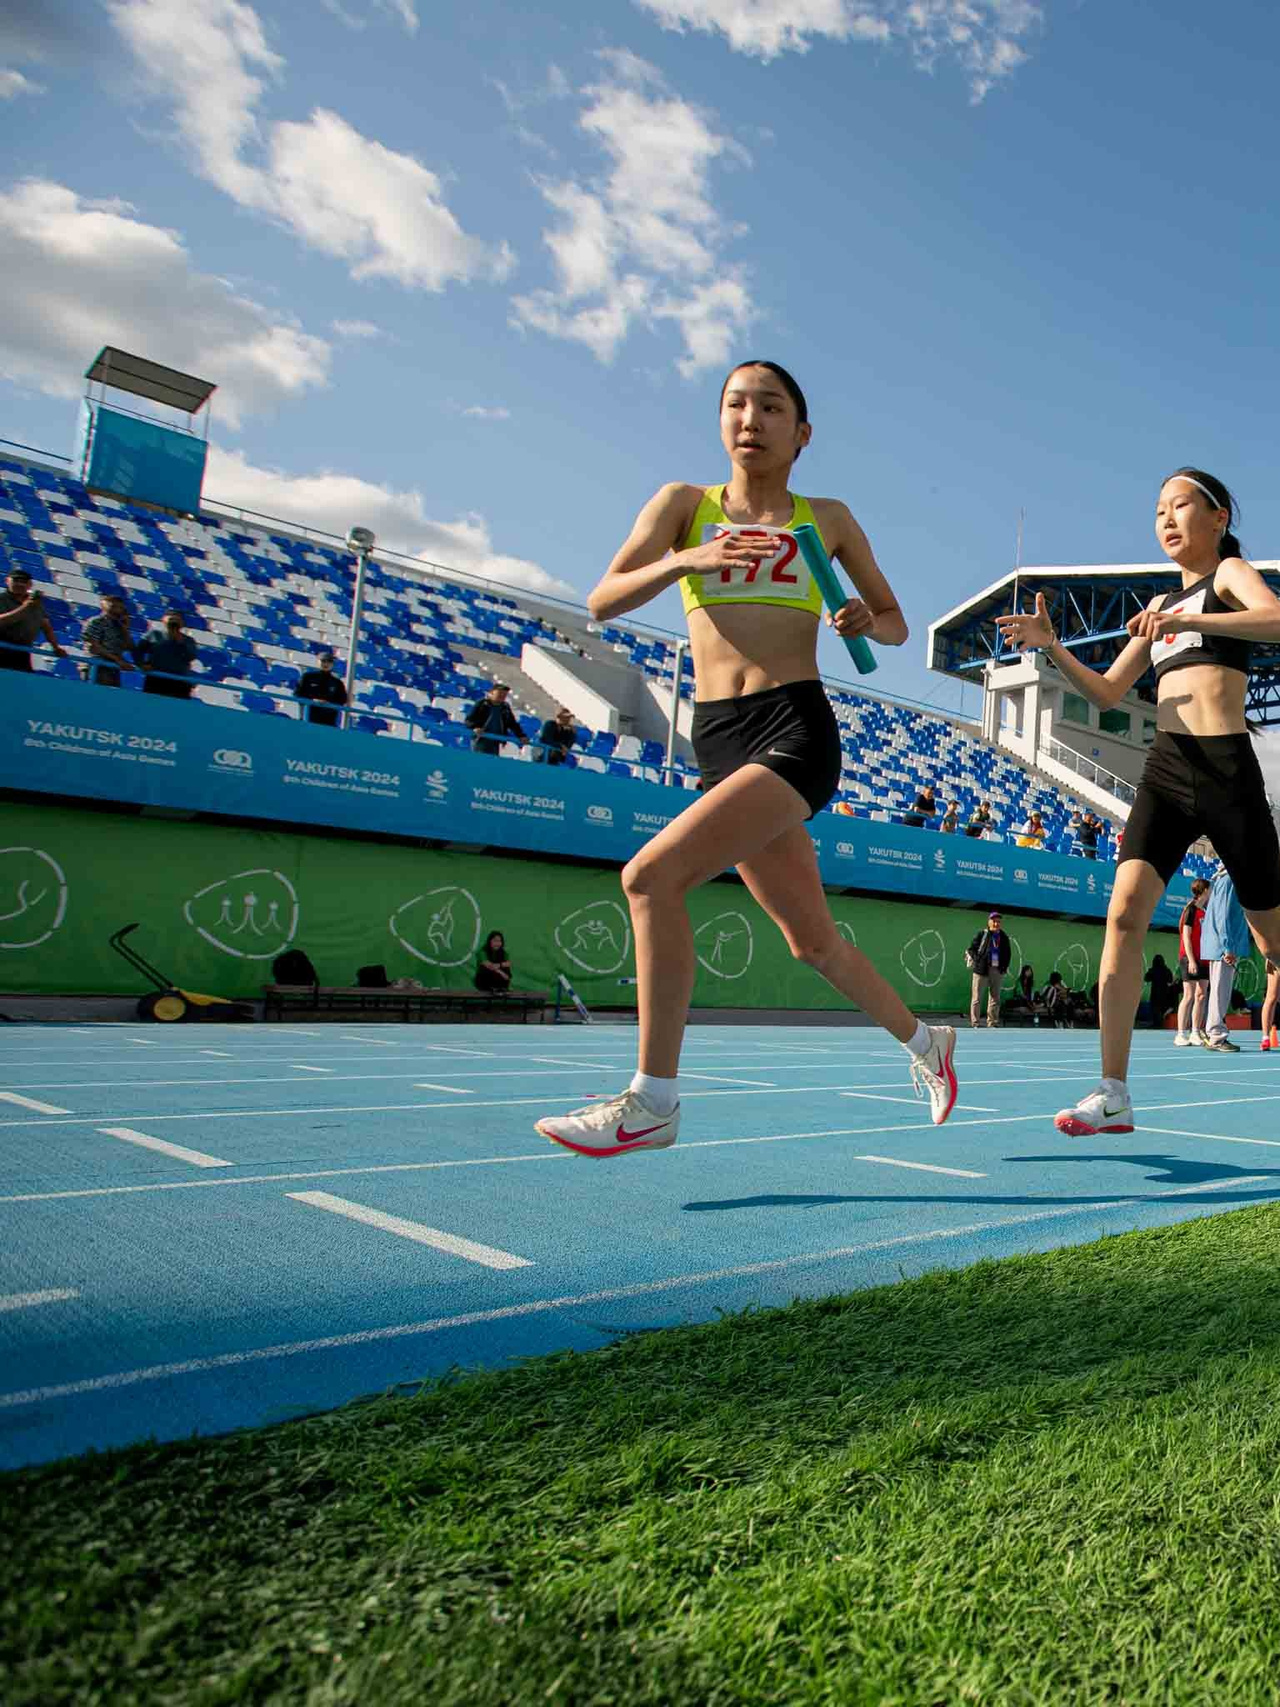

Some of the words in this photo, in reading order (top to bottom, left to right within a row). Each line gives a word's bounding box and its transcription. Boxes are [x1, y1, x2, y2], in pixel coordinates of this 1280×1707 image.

[27, 720, 123, 745] YAKUTSK
[126, 736, 178, 753] 2024
[286, 759, 358, 780] YAKUTSK
[361, 770, 400, 786] 2024
[473, 787, 532, 806] YAKUTSK
[533, 796, 564, 810] 2024
[633, 811, 674, 827] YAKUT
[868, 846, 902, 859] YAKUTSK
[904, 851, 922, 862] 2024
